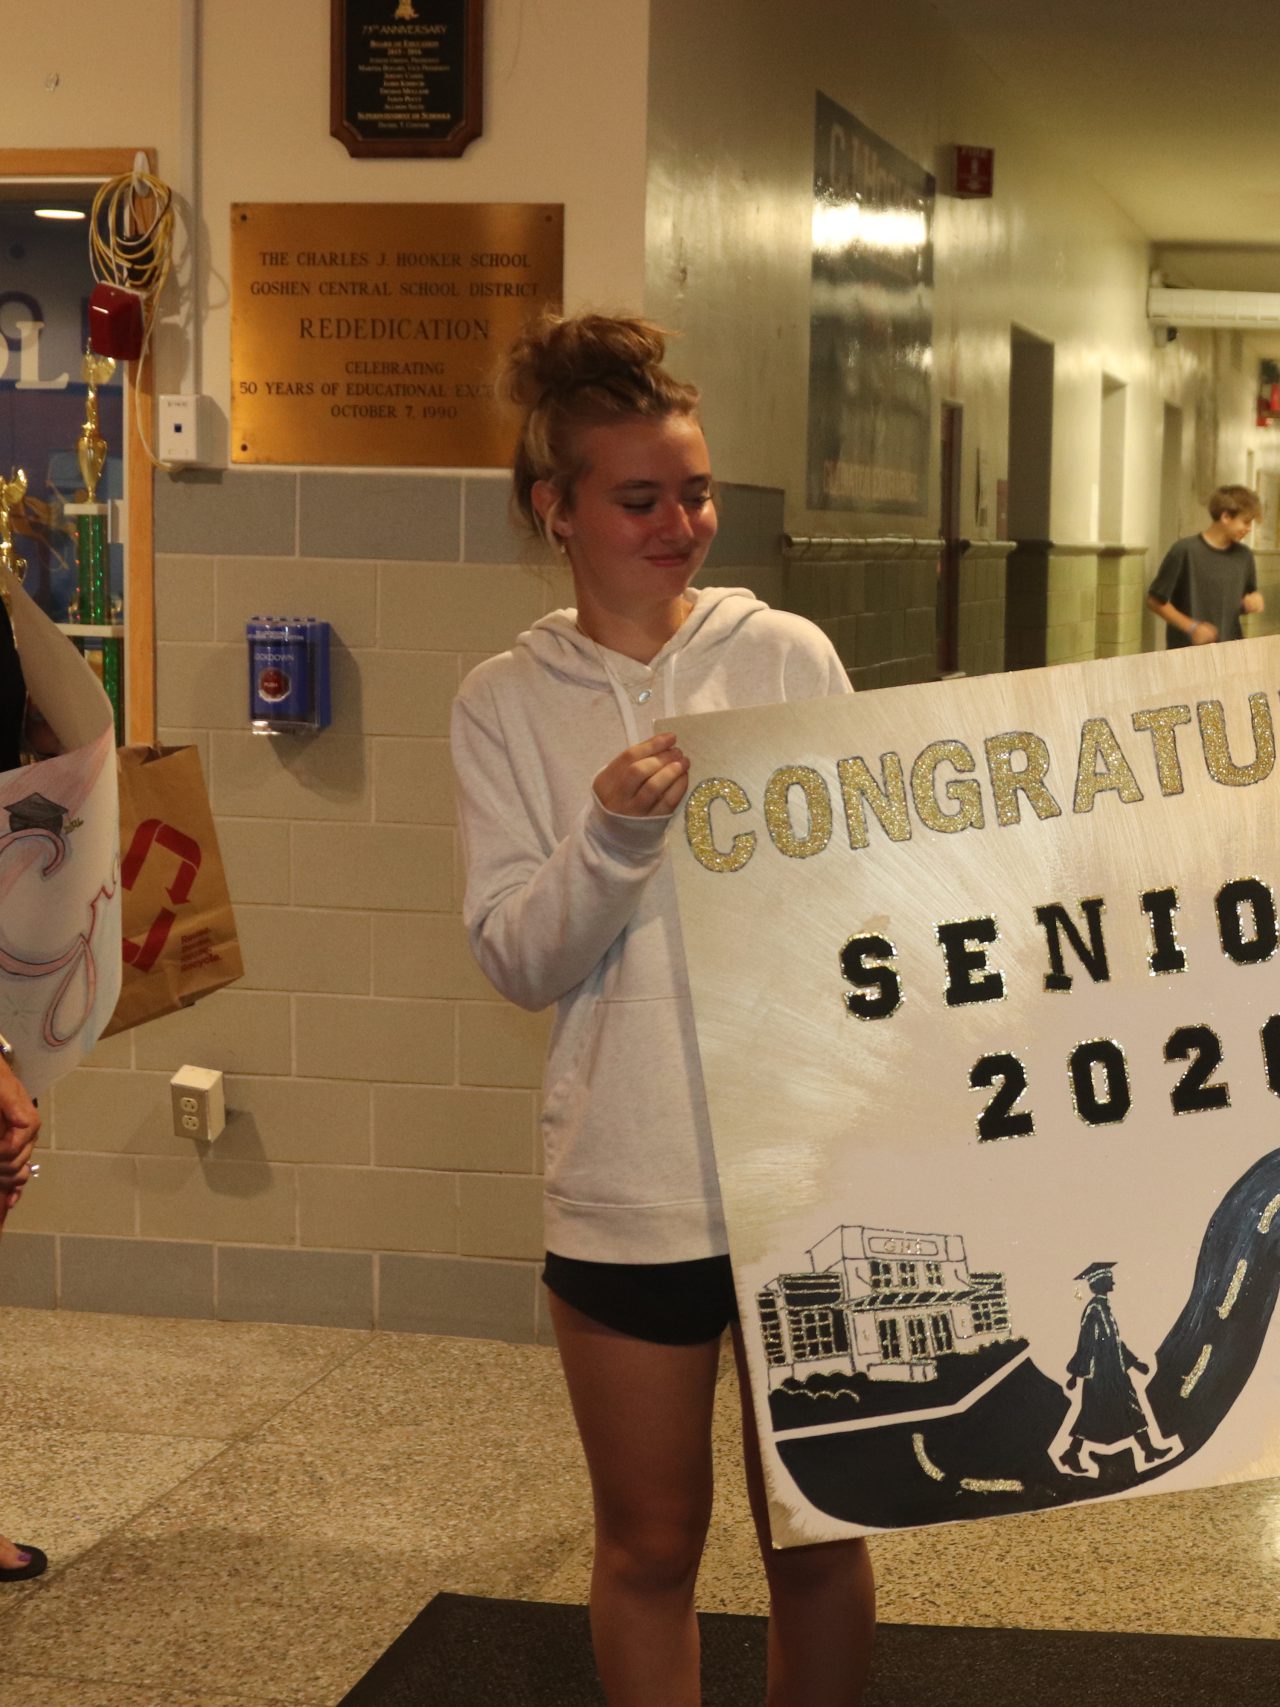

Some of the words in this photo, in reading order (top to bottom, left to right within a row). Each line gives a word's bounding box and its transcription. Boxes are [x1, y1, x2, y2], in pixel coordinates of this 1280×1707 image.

[259, 252, 289, 266] THE
[297, 252, 368, 266] CHARLES
[377, 253, 389, 266] J.
[396, 253, 462, 267] HOOKER
[470, 253, 531, 267] SCHOOL
[250, 281, 311, 295] GOSHEN
[319, 282, 392, 296] CENTRAL
[400, 282, 459, 296] SCHOOL
[469, 282, 539, 296] DISTRICT
[300, 317, 489, 340] REDEDICATION
[345, 361, 444, 375] CELEBRATING
[239, 382, 258, 394] 50
[265, 382, 315, 396] YEARS
[321, 383, 339, 396] OF
[346, 383, 443, 397] EDUCATIONAL
[331, 405, 397, 418] OCTOBER
[423, 406, 457, 419] 1990
